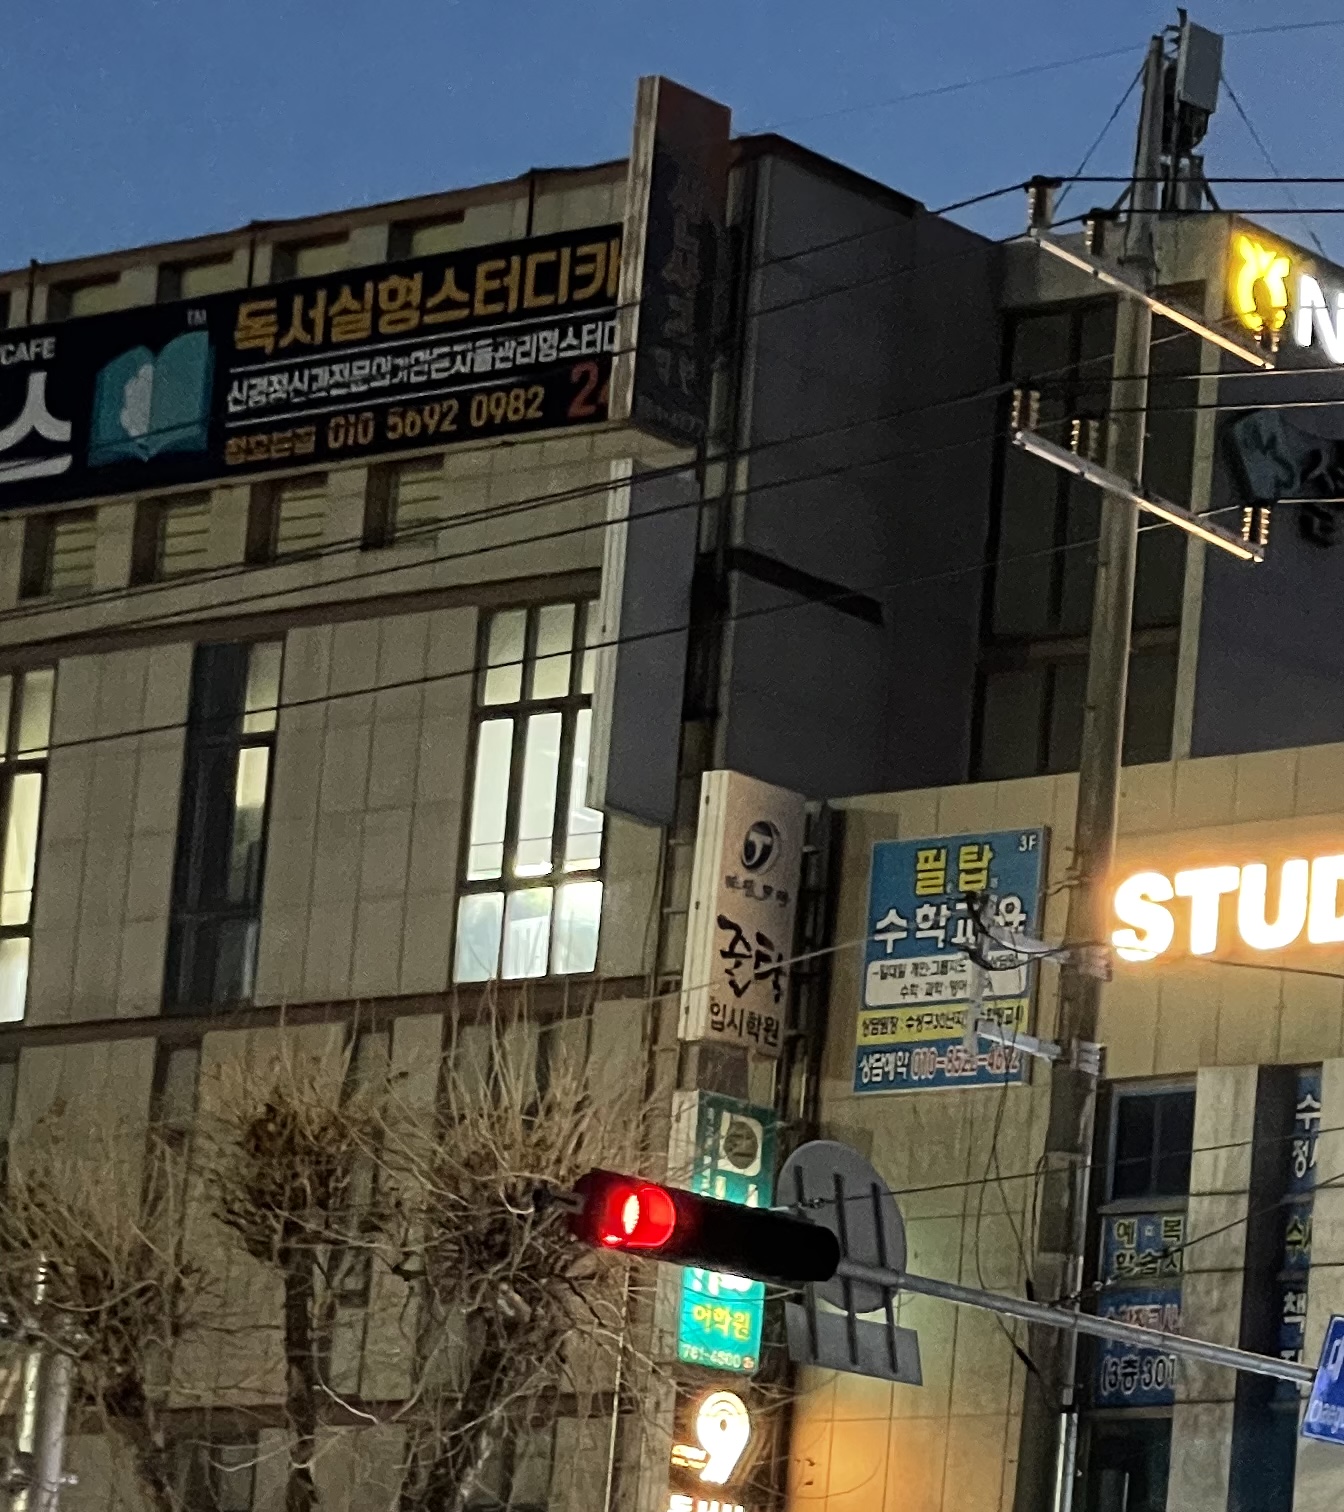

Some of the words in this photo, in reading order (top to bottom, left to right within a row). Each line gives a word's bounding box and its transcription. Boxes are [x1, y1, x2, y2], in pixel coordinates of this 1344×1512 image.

[0, 336, 56, 366] CAFE
[328, 411, 374, 449] 010
[387, 401, 459, 440] 5692
[470, 385, 545, 427] 0982
[1019, 835, 1037, 852] 3F
[916, 844, 993, 896] 필탑
[708, 1003, 780, 1047] 입시학원
[693, 1304, 750, 1341] 어학원
